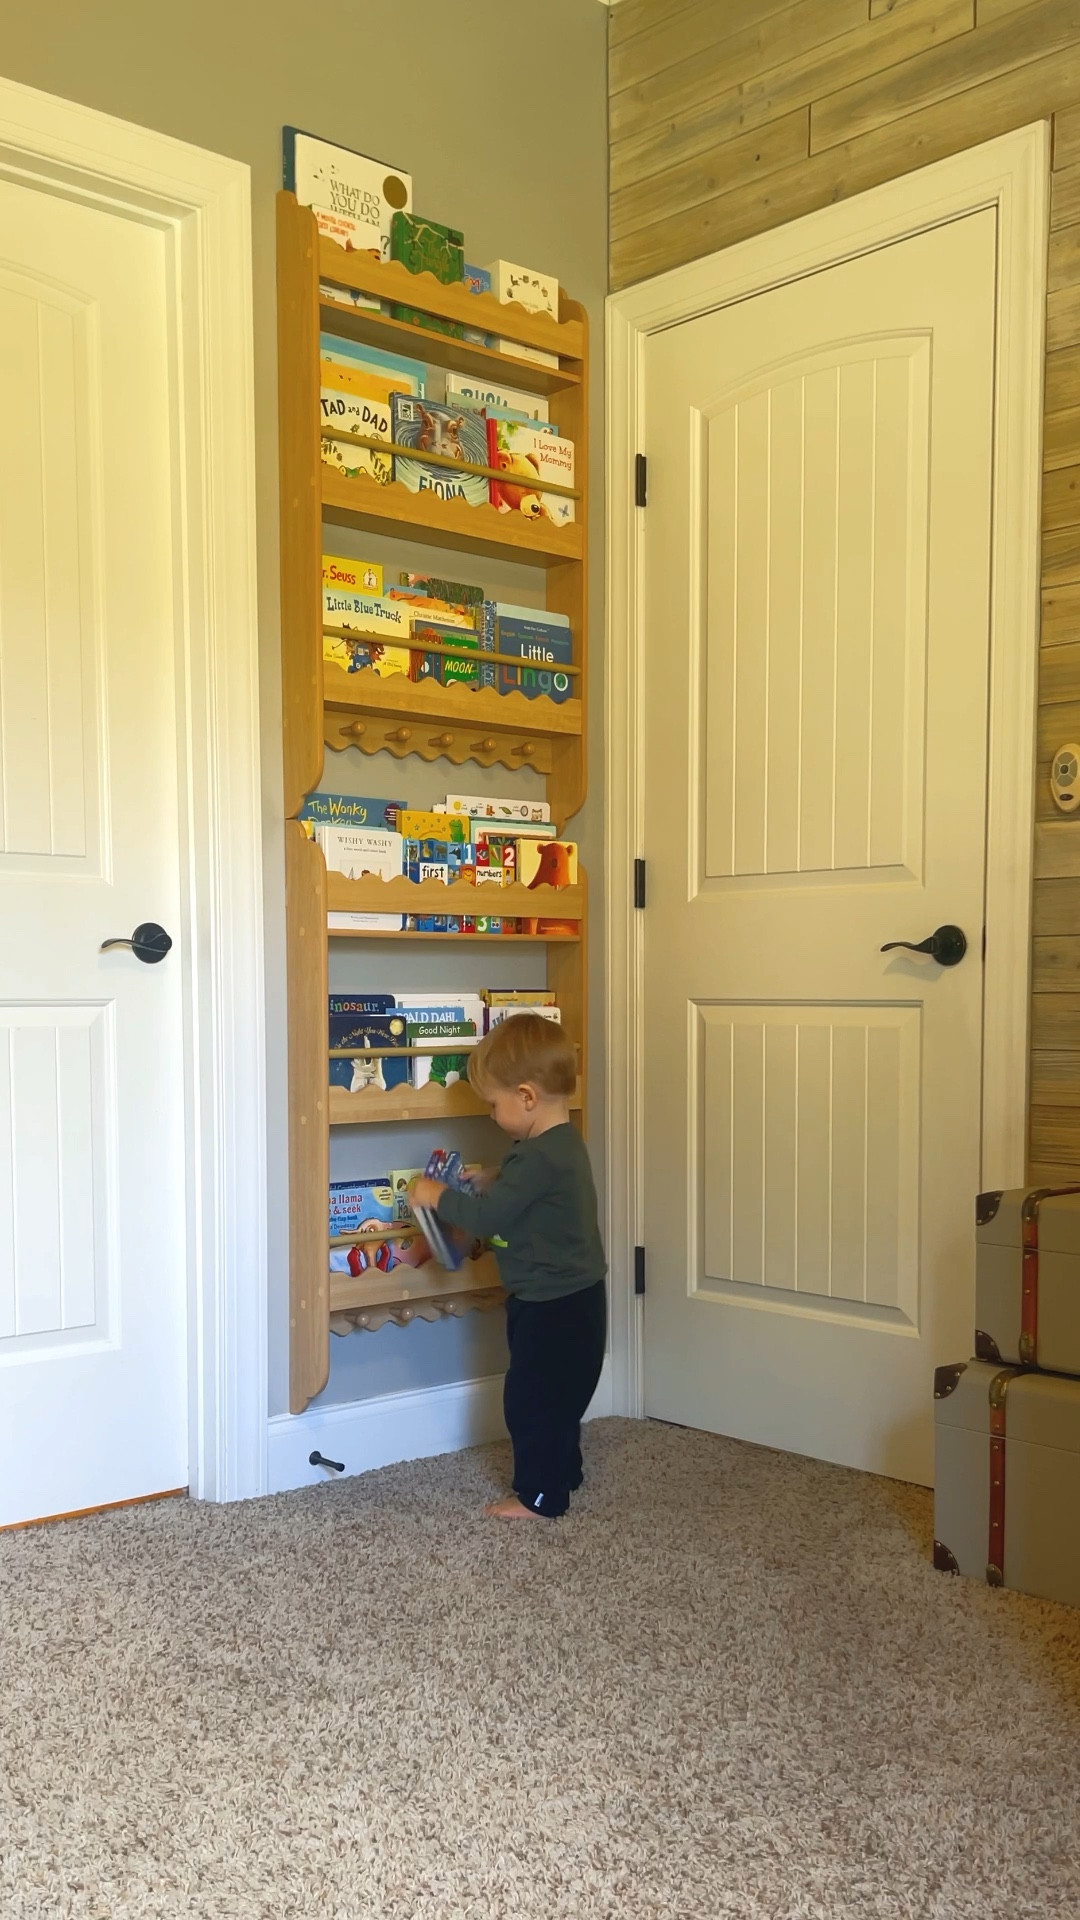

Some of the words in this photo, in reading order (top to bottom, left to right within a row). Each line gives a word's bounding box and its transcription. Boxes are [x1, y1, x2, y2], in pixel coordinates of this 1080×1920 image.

[330, 179, 361, 200] WHAT
[363, 192, 380, 206] DO
[330, 191, 357, 212] YOU
[360, 203, 380, 219] DO
[320, 398, 345, 417] TAD
[348, 406, 360, 416] and
[362, 405, 388, 433] DAD
[533, 437, 537, 449] I
[538, 439, 557, 453] Love
[558, 445, 572, 459] My
[540, 452, 572, 471] Mommy
[330, 564, 357, 585] Seuss
[326, 596, 352, 611] Little
[353, 599, 374, 614] Blue
[374, 602, 402, 624] Truck
[520, 642, 554, 663] Little
[444, 659, 474, 675] MOON
[502, 663, 569, 694] Lingo
[308, 800, 328, 815] The
[328, 797, 367, 824] Wonky
[337, 836, 364, 845] WISHY
[365, 838, 393, 847] WASHY
[503, 847, 515, 866] 2
[422, 866, 445, 878] first
[476, 869, 502, 879] numbers
[477, 916, 488, 932] 3
[330, 999, 380, 1013] inosaur.
[430, 1011, 458, 1023] DAHL
[418, 1025, 438, 1035] Good
[439, 1025, 461, 1036] Night
[338, 1193, 363, 1204] llama
[342, 1203, 361, 1214] seek
